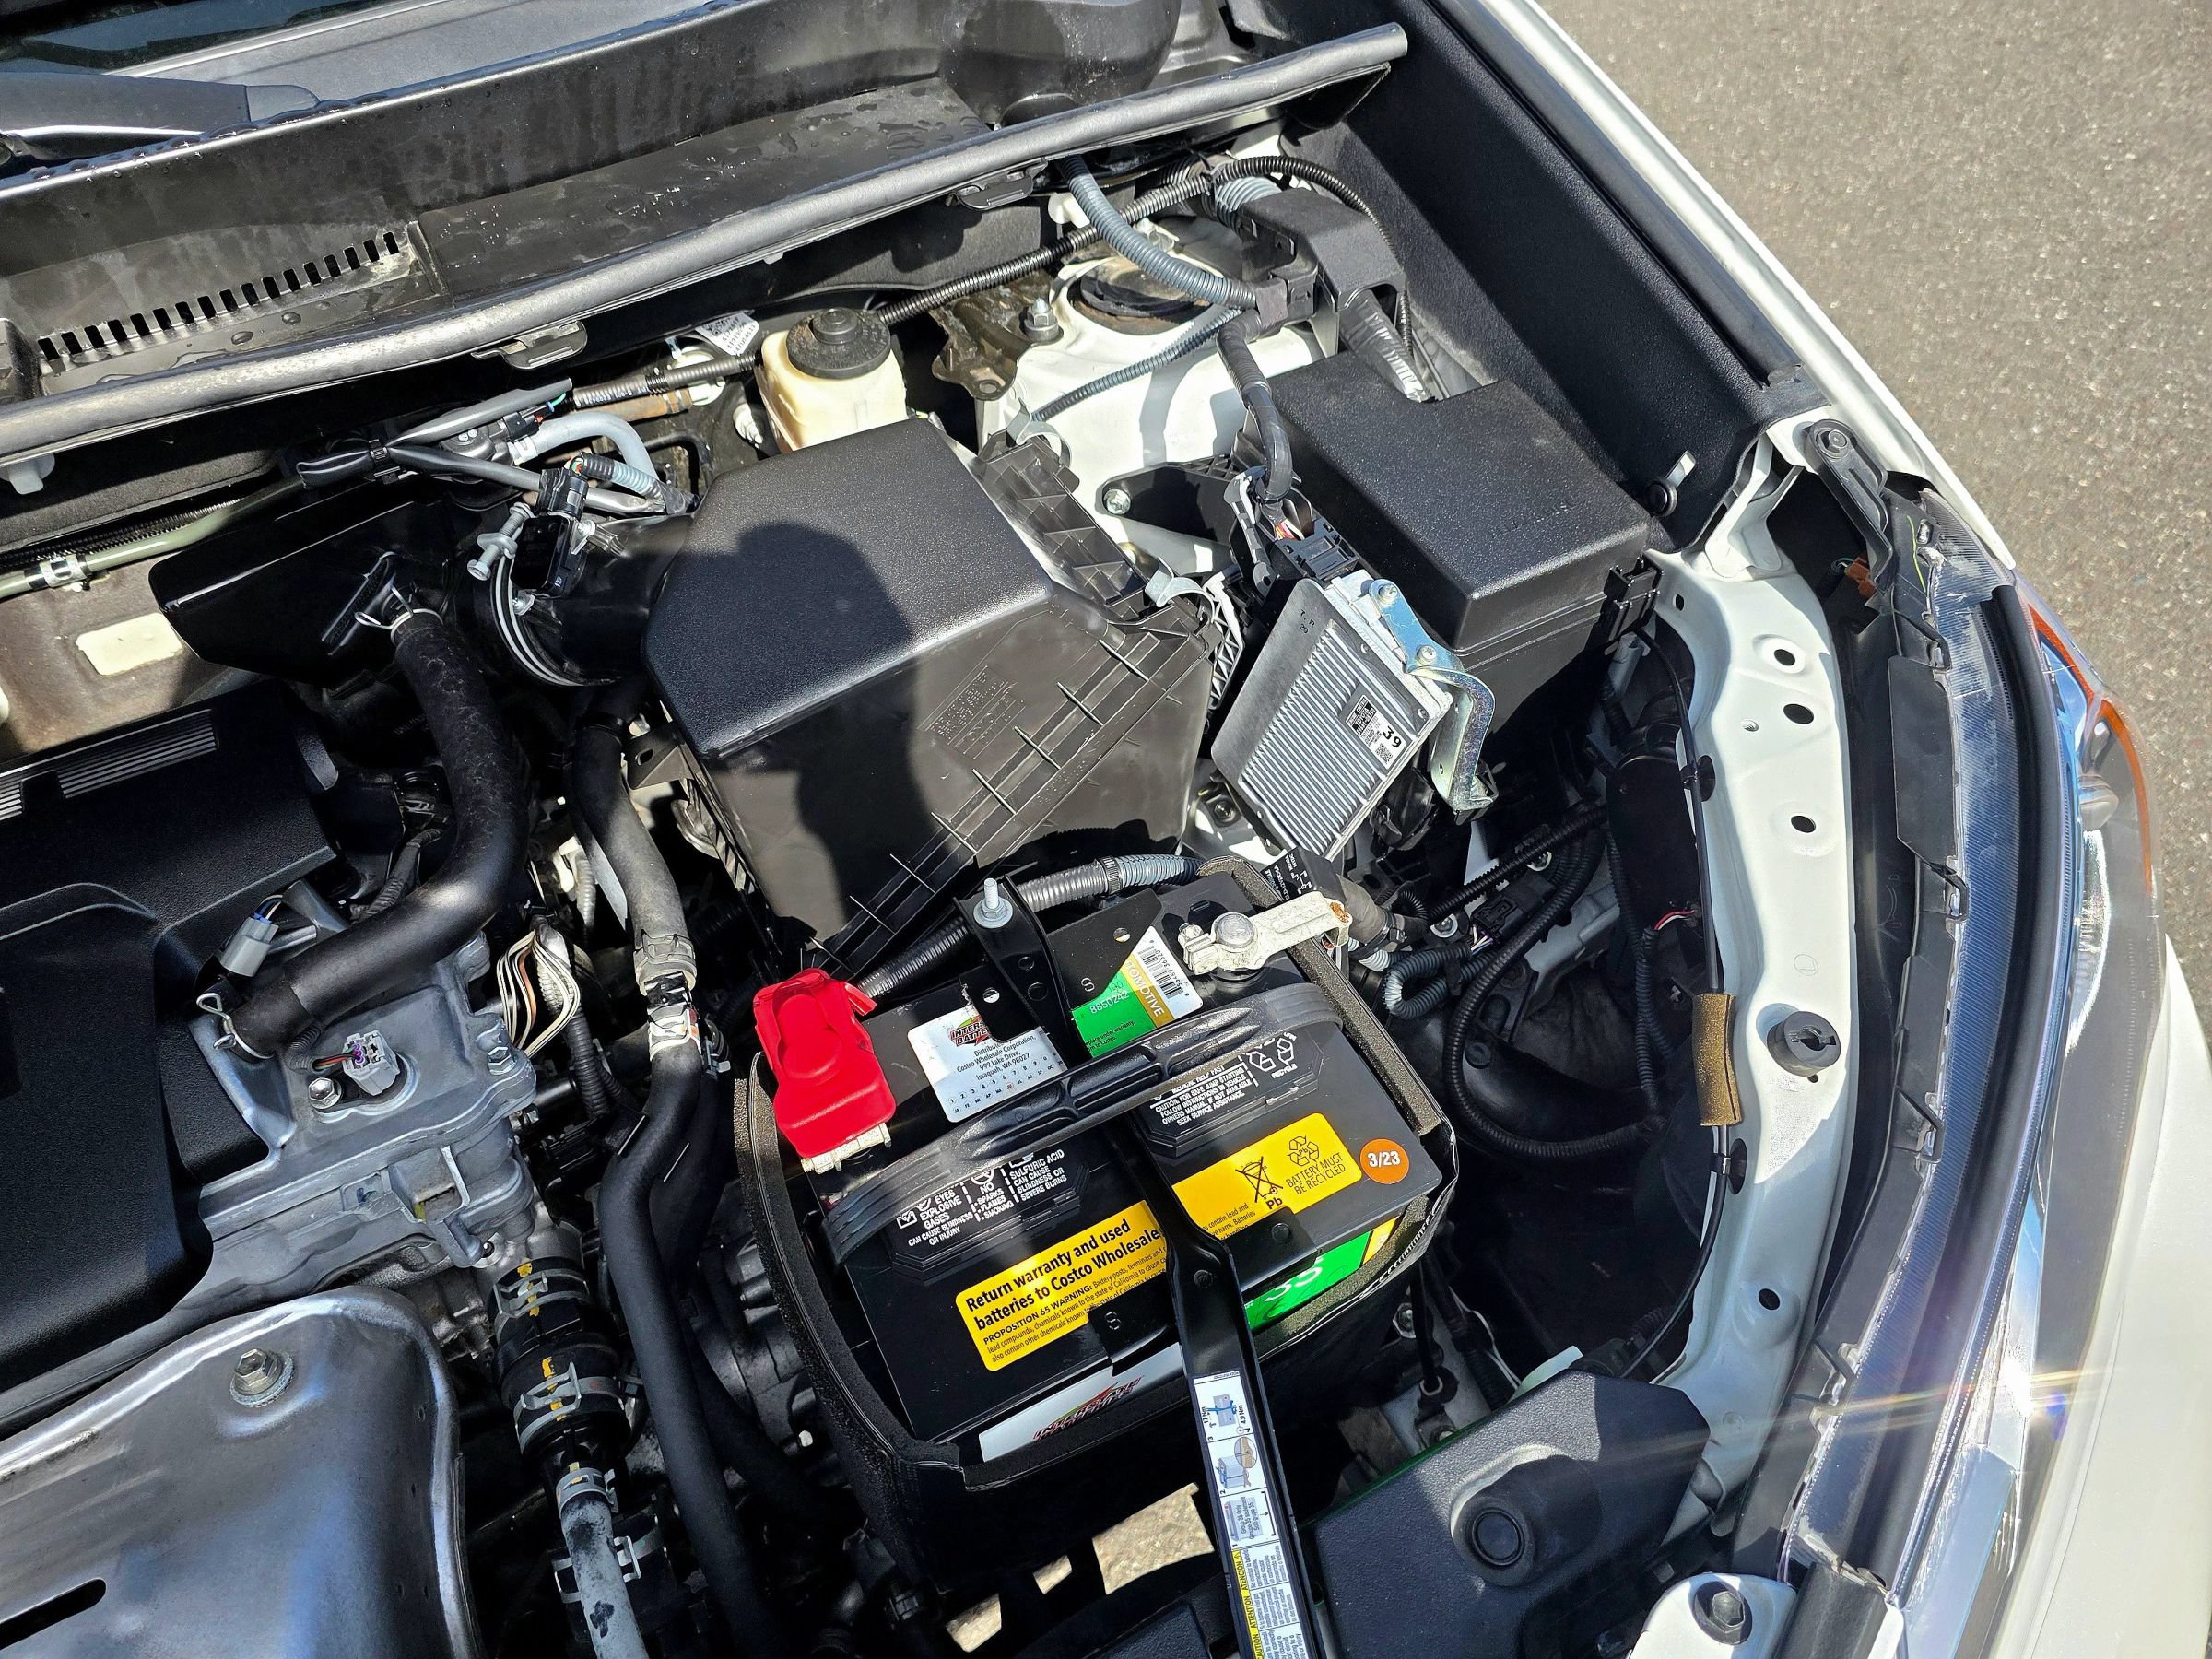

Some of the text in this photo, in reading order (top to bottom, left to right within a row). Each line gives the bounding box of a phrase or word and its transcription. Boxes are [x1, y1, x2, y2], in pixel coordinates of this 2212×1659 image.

[1382, 726, 1401, 747] 39
[1127, 961, 1163, 1015] TOMOTIVE
[1089, 991, 1129, 1013] 8850242
[950, 1020, 984, 1038] INTERS
[955, 1028, 988, 1046] BATTE
[1085, 1036, 1100, 1047] eplace
[1100, 1030, 1114, 1039] under
[957, 1034, 1035, 1073] Costco Wholesale Corporation,
[974, 1041, 1000, 1056] Distribut
[979, 1048, 1020, 1071] 999 Lake Drive,
[976, 1052, 1030, 1080] Issaquah, WA 98027
[1160, 1103, 1181, 1118] FOLLOW
[1182, 1088, 1218, 1107] INSTRUCTIONS
[1225, 1073, 1245, 1088] VEHICLE
[1179, 1091, 1191, 1101] FOR
[1190, 1085, 1205, 1096] SAFE
[1204, 1078, 1218, 1089] JUMP
[1218, 1067, 1243, 1082] STARTING
[1162, 1111, 1184, 1124] OWNERS
[1213, 1090, 1225, 1100] NOT
[1226, 1079, 1251, 1094] AVAILABLE
[1176, 1114, 1191, 1125] SEEK
[1192, 1104, 1212, 1119] SERVICE
[1298, 1147, 1308, 1155] Pb
[1367, 1150, 1400, 1167] 3/23
[1009, 1149, 1064, 1180] SULFURIC ACID
[1013, 1165, 1049, 1187] CAN CAUSE
[1286, 1152, 1342, 1187] BATTERY MUST
[979, 1182, 995, 1194] NO
[1017, 1166, 1065, 1193] BLINDNESS OR
[1020, 1174, 1066, 1200] SEVERE BURNS
[1293, 1163, 1346, 1195] BE RECYCLED
[919, 1195, 961, 1220] EXPLOSIVE
[935, 1189, 955, 1203] EYES
[977, 1188, 1003, 1204] SPARKS
[980, 1195, 1006, 1211] FLAMES
[1265, 1195, 1283, 1209] Pb
[924, 1212, 949, 1229] GASES
[983, 1200, 1014, 1218] SMOKING
[1208, 1215, 1227, 1228] contain
[1226, 1208, 1238, 1218] lead
[1237, 1202, 1248, 1212] and
[907, 1211, 973, 1247] CAN CAUSE BLINDNESS
[1218, 1221, 1233, 1233] harm.
[1233, 1210, 1254, 1224] Batteries
[928, 1226, 960, 1246] OR INJURY
[965, 1218, 1130, 1311] Return warranty and used
[975, 1226, 1159, 1330] batteries to Costco Wholesale
[984, 1312, 1037, 1344] PROPOSITION
[1039, 1305, 1051, 1316] 65
[1051, 1285, 1092, 1309] WARNING:
[1093, 1275, 1112, 1288] Battery
[1112, 1265, 1128, 1279] posts,
[1127, 1253, 1151, 1269] terminals
[1151, 1247, 1162, 1257] and
[986, 1341, 1001, 1353] lead
[999, 1325, 1033, 1347] compounds,
[1033, 1311, 1060, 1328] chemicals
[1060, 1301, 1078, 1315] known
[1077, 1298, 1085, 1306] to
[1083, 1292, 1095, 1302] the
[1093, 1286, 1109, 1298] state
[1106, 1282, 1114, 1291] of
[1113, 1270, 1138, 1287] California
[1137, 1266, 1145, 1275] to
[1144, 1259, 1160, 1272] cause
[990, 1350, 1004, 1362] also
[1003, 1341, 1024, 1355] contain
[1023, 1332, 1040, 1346] other
[1039, 1319, 1065, 1336] chemicals
[1065, 1309, 1084, 1324] known
[1238, 1405, 1243, 1415] Nm
